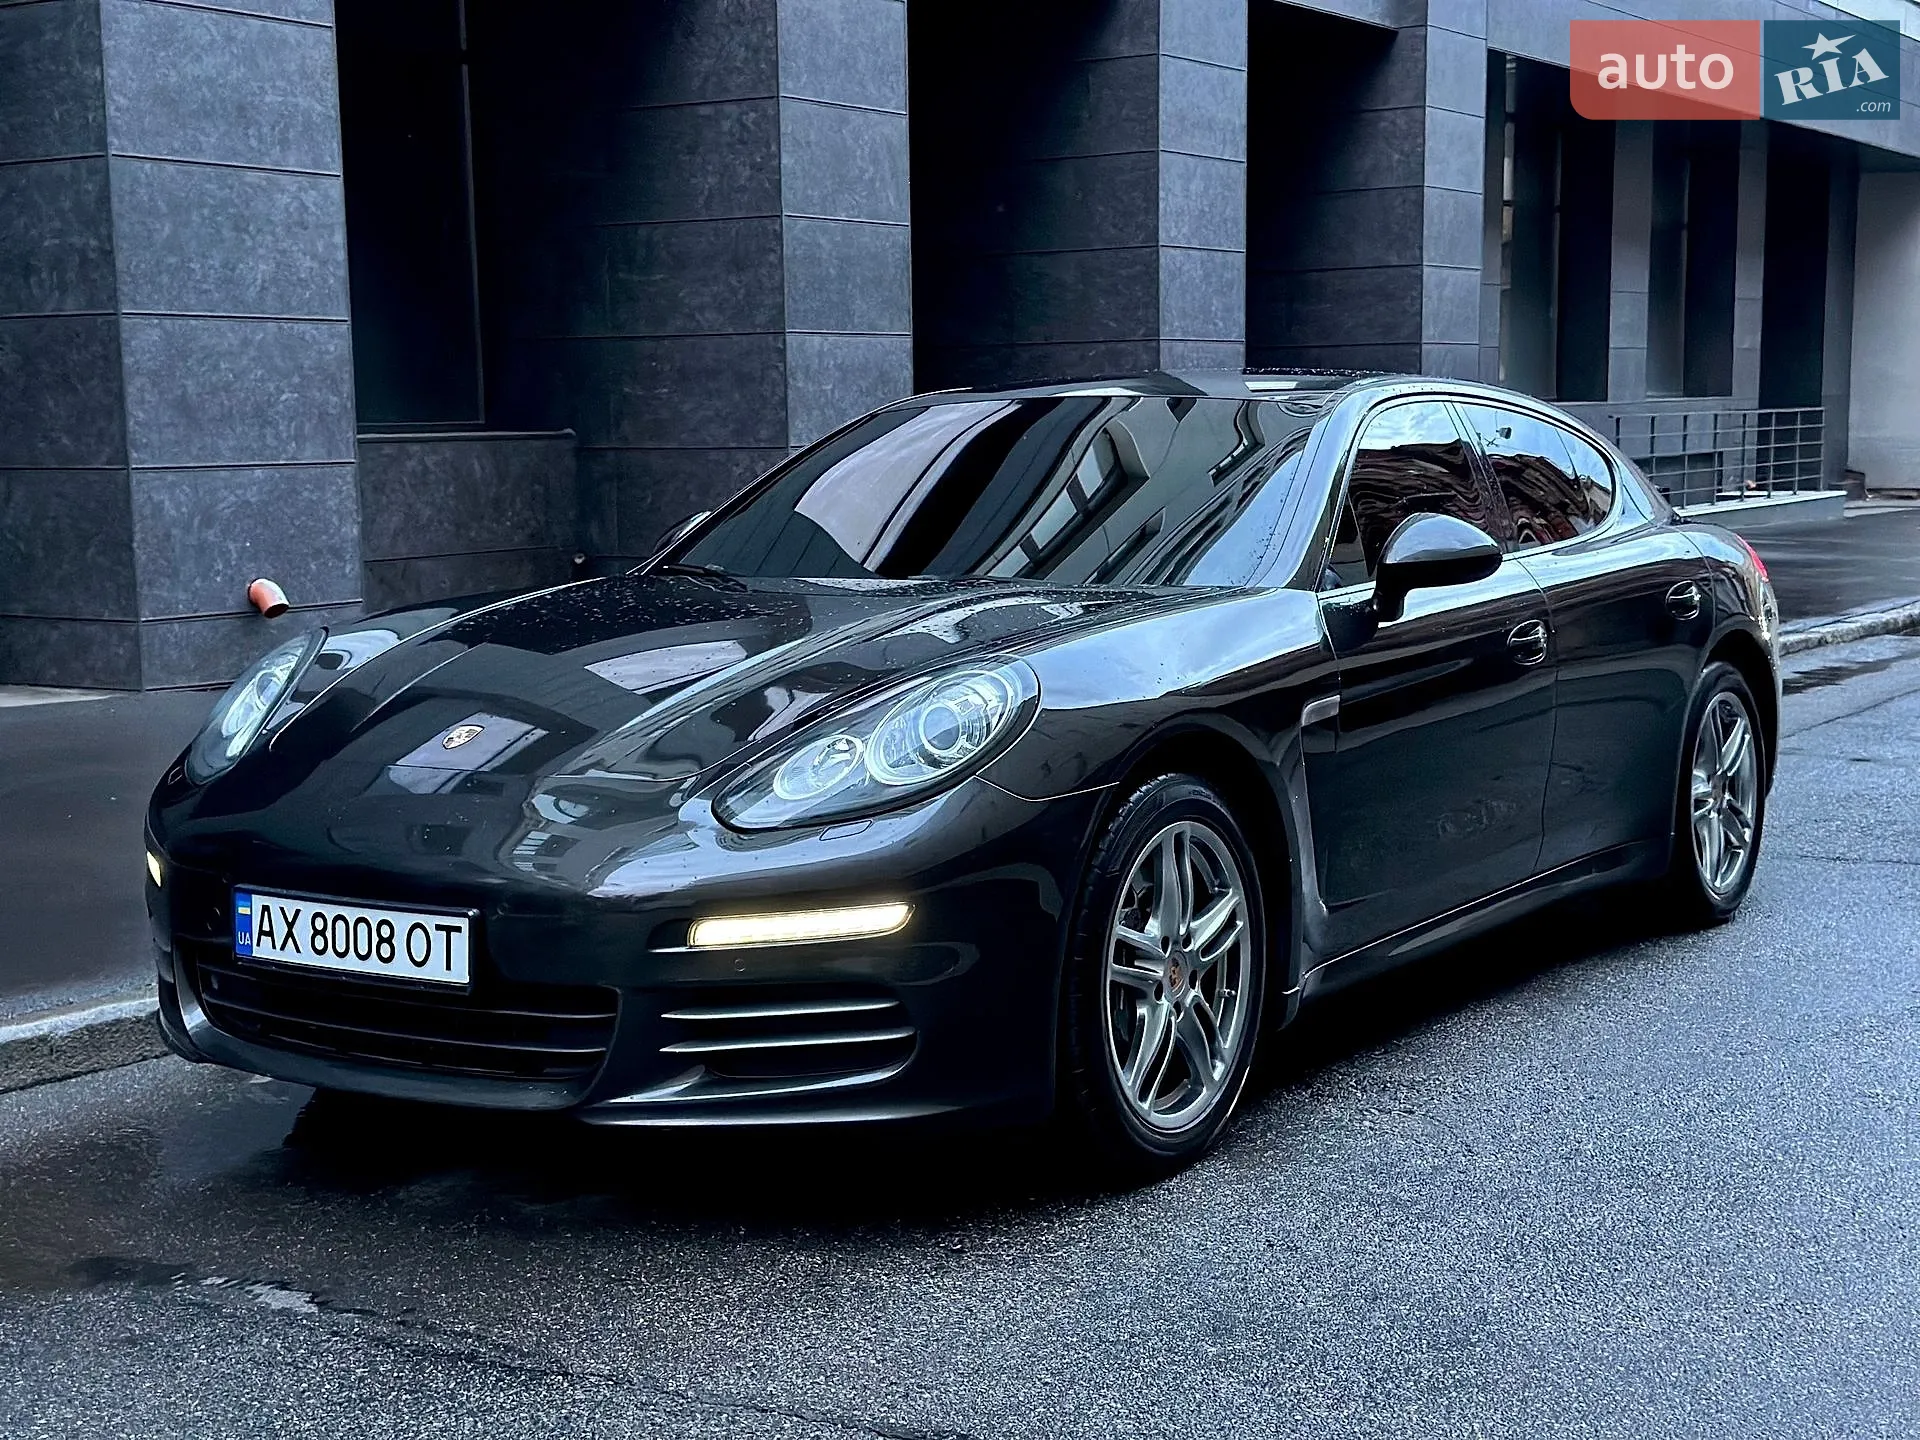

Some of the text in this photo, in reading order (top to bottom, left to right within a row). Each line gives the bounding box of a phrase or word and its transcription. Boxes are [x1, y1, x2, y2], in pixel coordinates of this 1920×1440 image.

[238, 931, 251, 946] UA
[256, 904, 463, 972] AX 8008 OT
